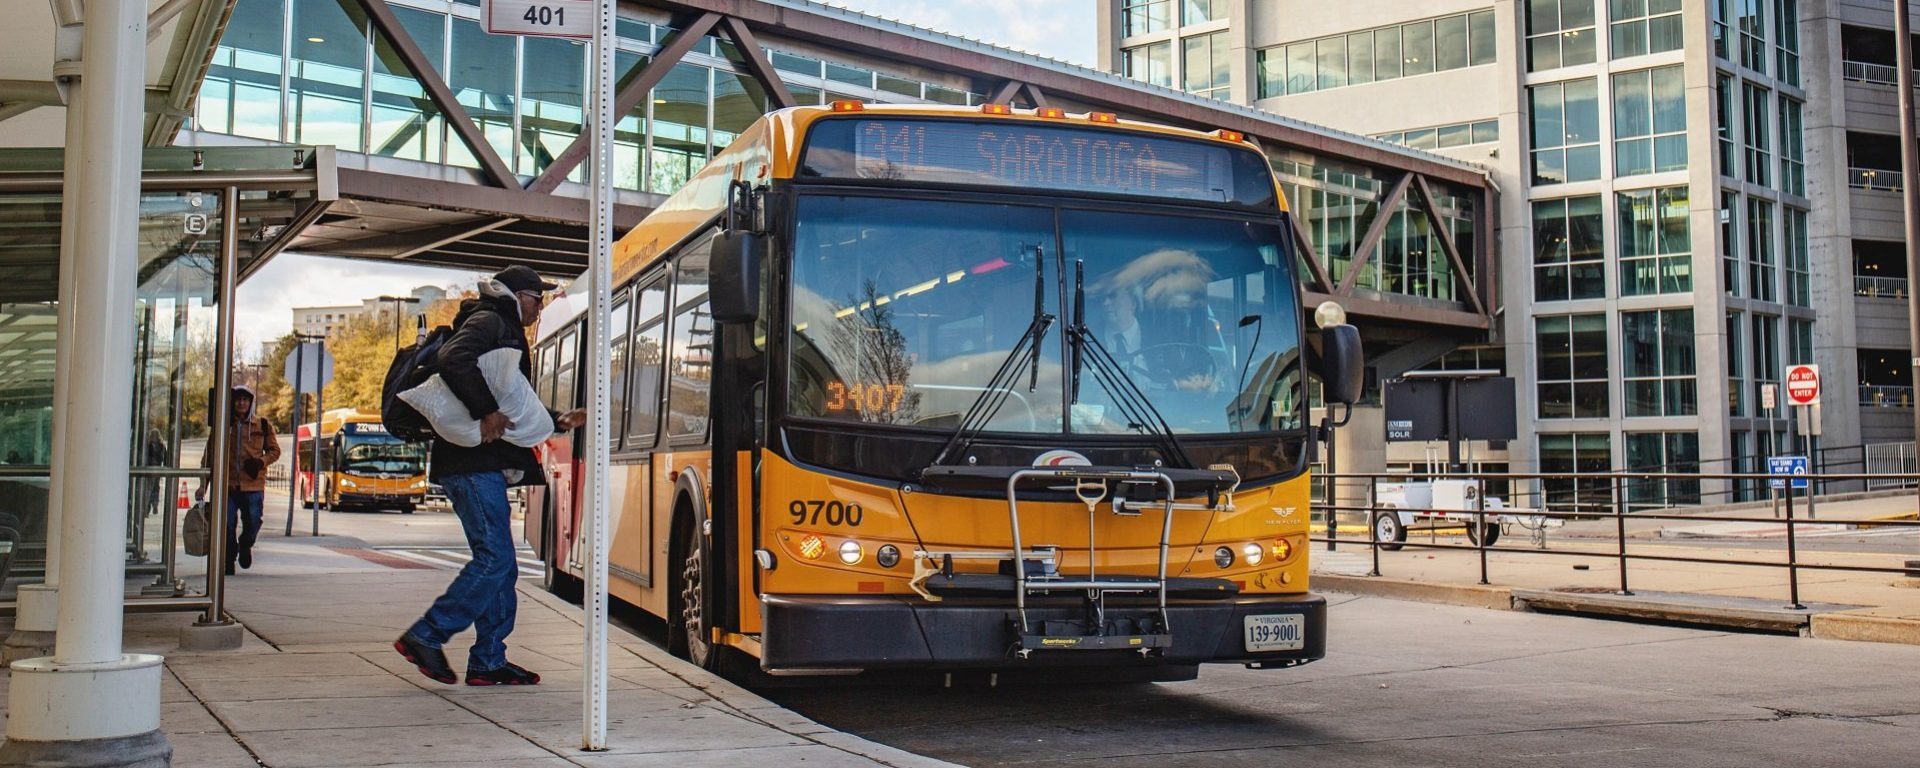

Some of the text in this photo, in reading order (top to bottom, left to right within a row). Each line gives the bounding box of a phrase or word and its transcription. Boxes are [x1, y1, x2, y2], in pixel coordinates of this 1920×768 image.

[523, 5, 564, 26] 401
[865, 121, 1158, 191] 341 SARATOGA
[189, 216, 202, 231] E
[1801, 372, 1814, 380] NOT
[827, 381, 904, 412] 3407
[1794, 389, 1812, 397] ENTER
[1389, 430, 1410, 438] SOLR
[789, 500, 863, 527] 9700
[1260, 616, 1290, 625] VIRGINIA
[1249, 624, 1301, 642] 139-900L
